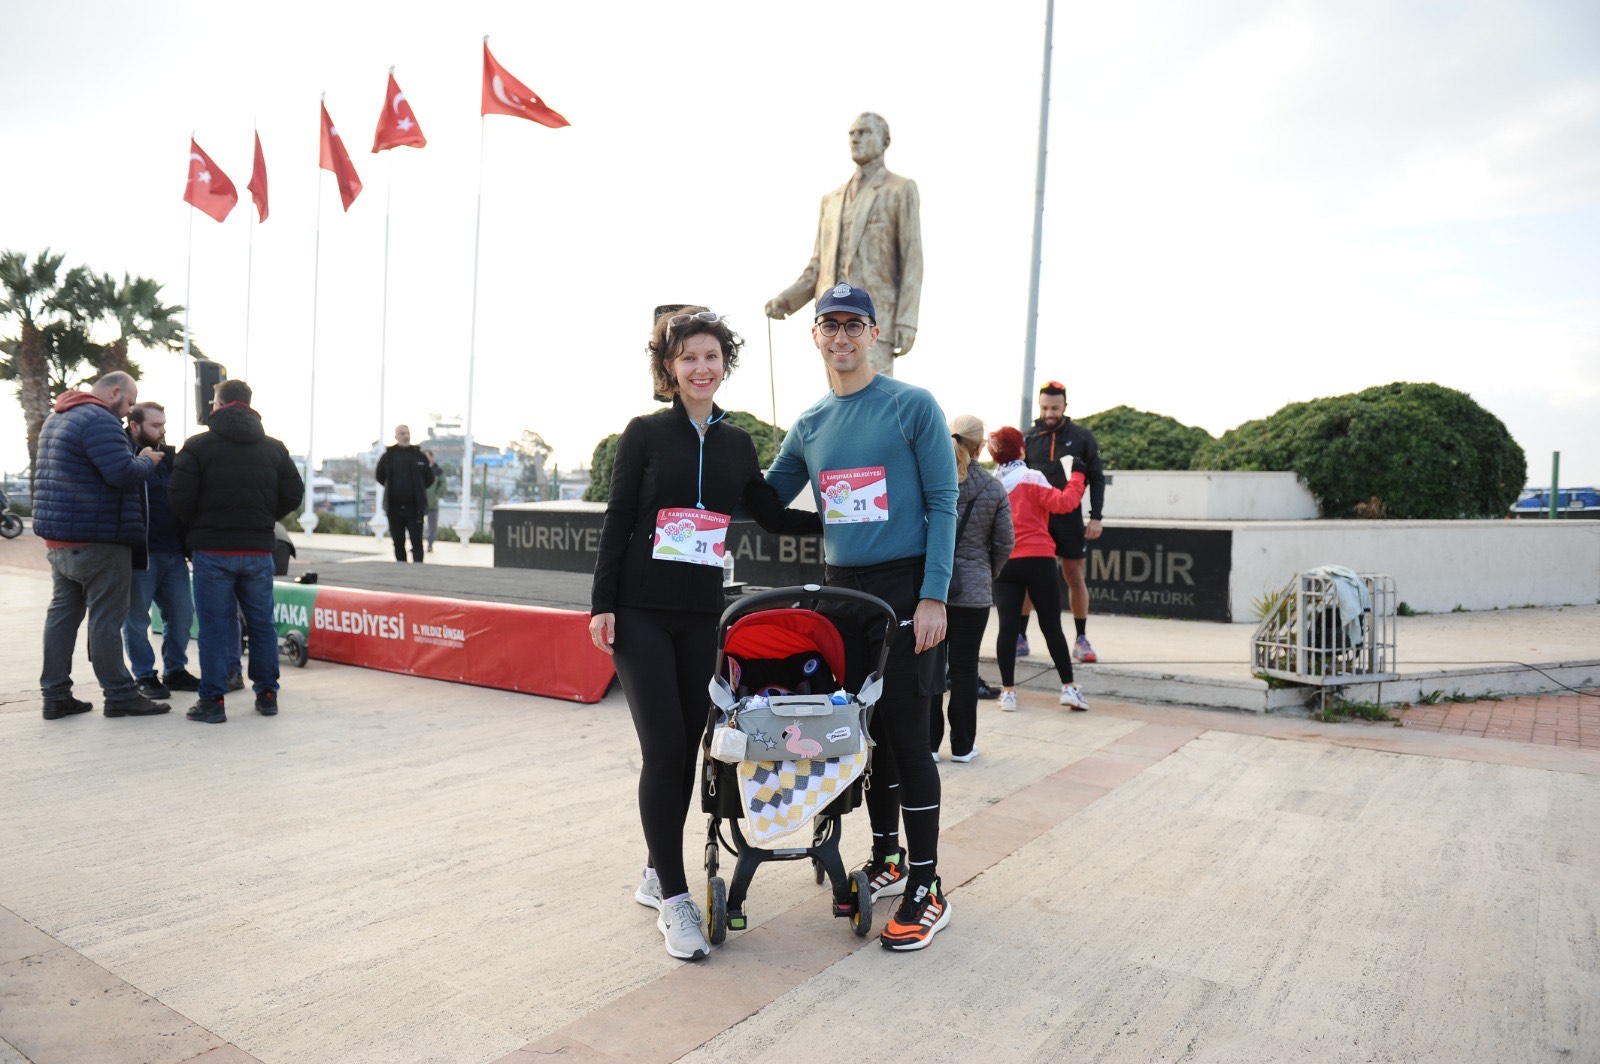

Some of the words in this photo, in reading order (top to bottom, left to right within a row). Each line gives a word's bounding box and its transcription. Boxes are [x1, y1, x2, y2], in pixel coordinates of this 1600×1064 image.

[853, 499, 866, 511] 21
[667, 511, 699, 519] KARŞIYAKA
[700, 514, 727, 524] BELEDİYESİ
[507, 521, 603, 552] HÜRRİYE
[695, 540, 707, 554] 21
[314, 608, 405, 640] BELEDİYESİ
[442, 624, 466, 641] ÜNSAL
